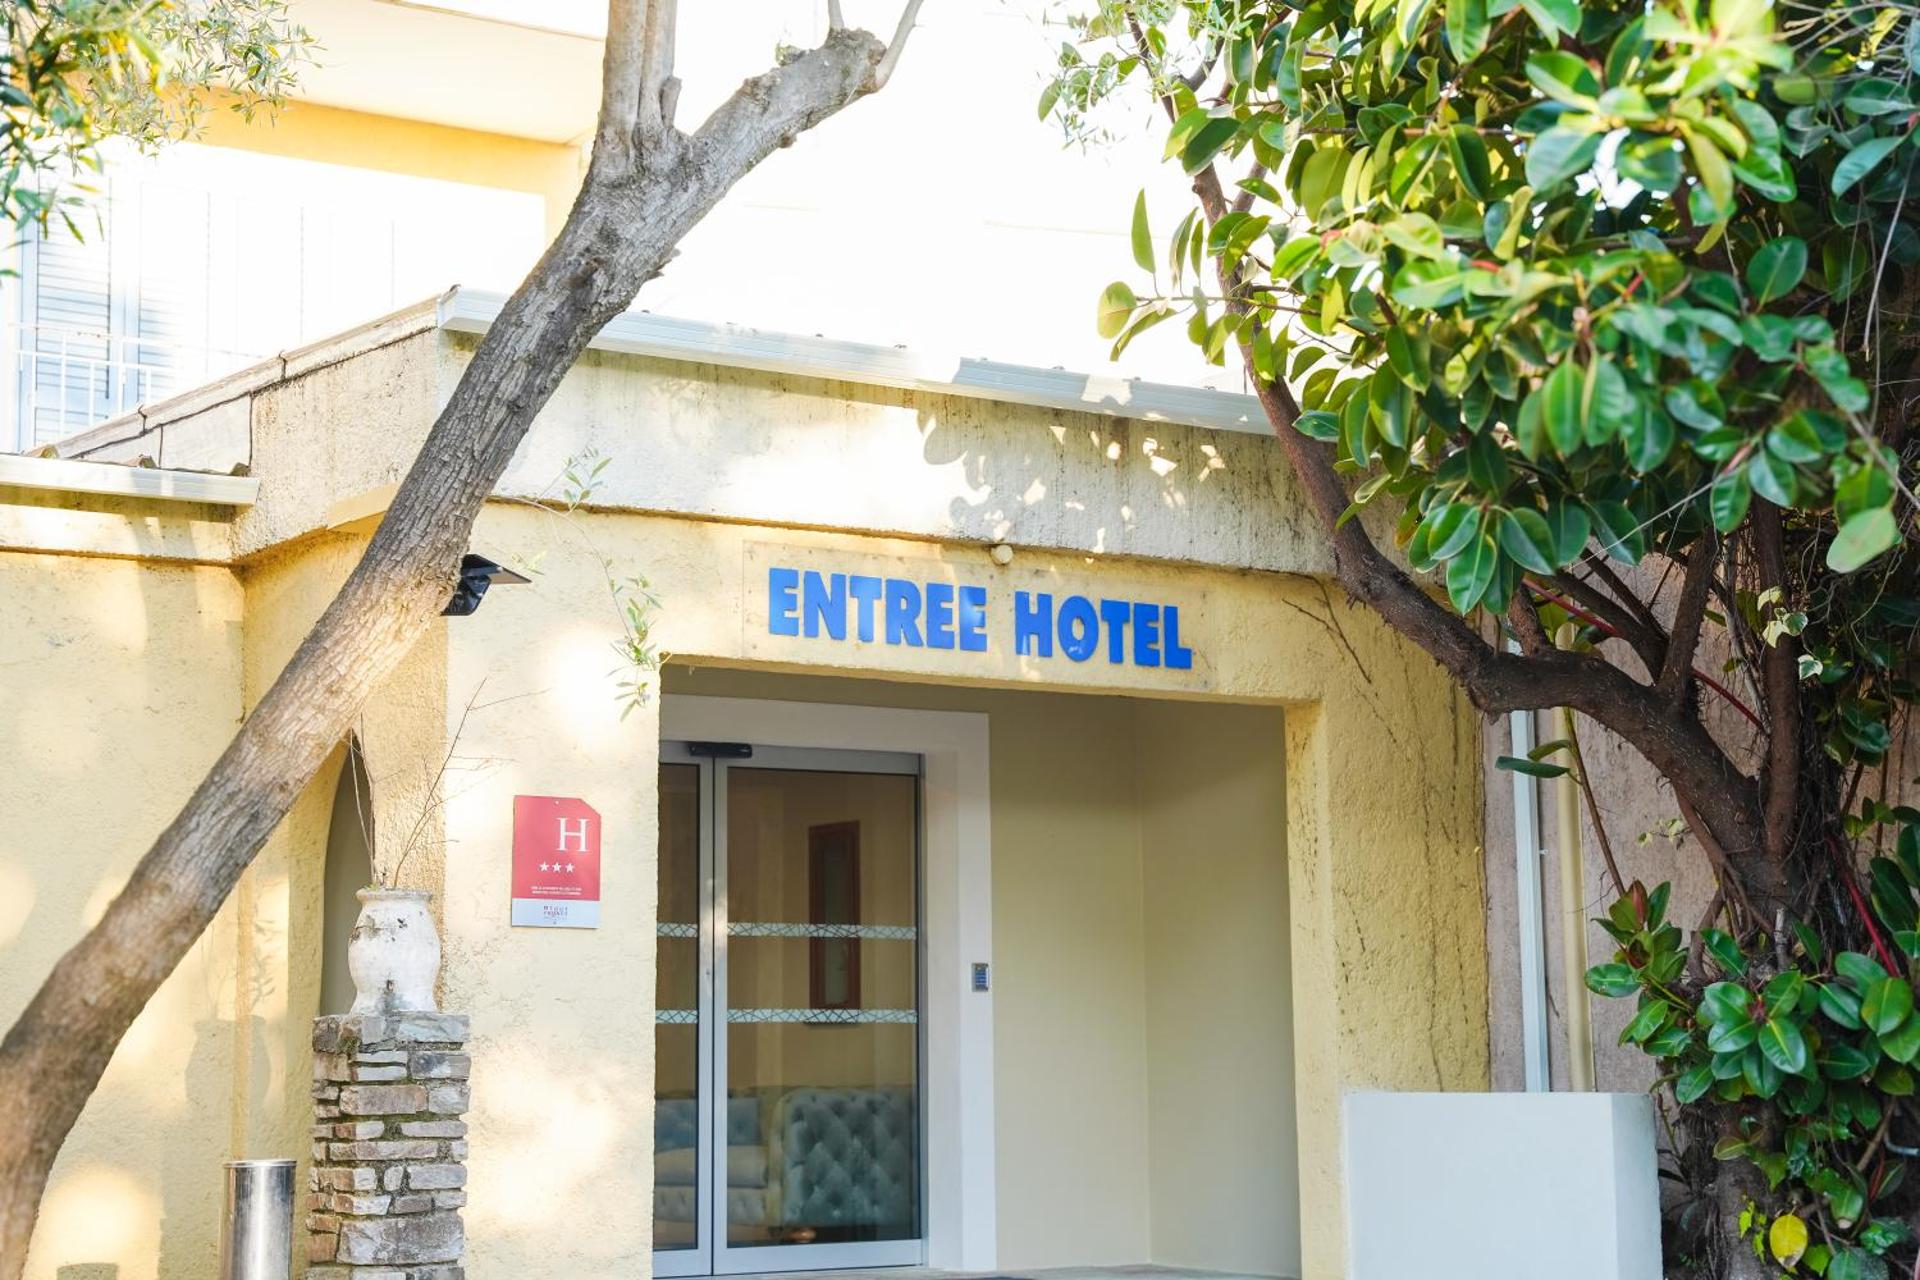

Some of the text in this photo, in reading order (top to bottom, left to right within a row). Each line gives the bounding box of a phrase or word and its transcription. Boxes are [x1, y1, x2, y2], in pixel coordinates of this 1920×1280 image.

[769, 567, 1193, 670] ENTREE HOTEL
[556, 817, 591, 852] H
